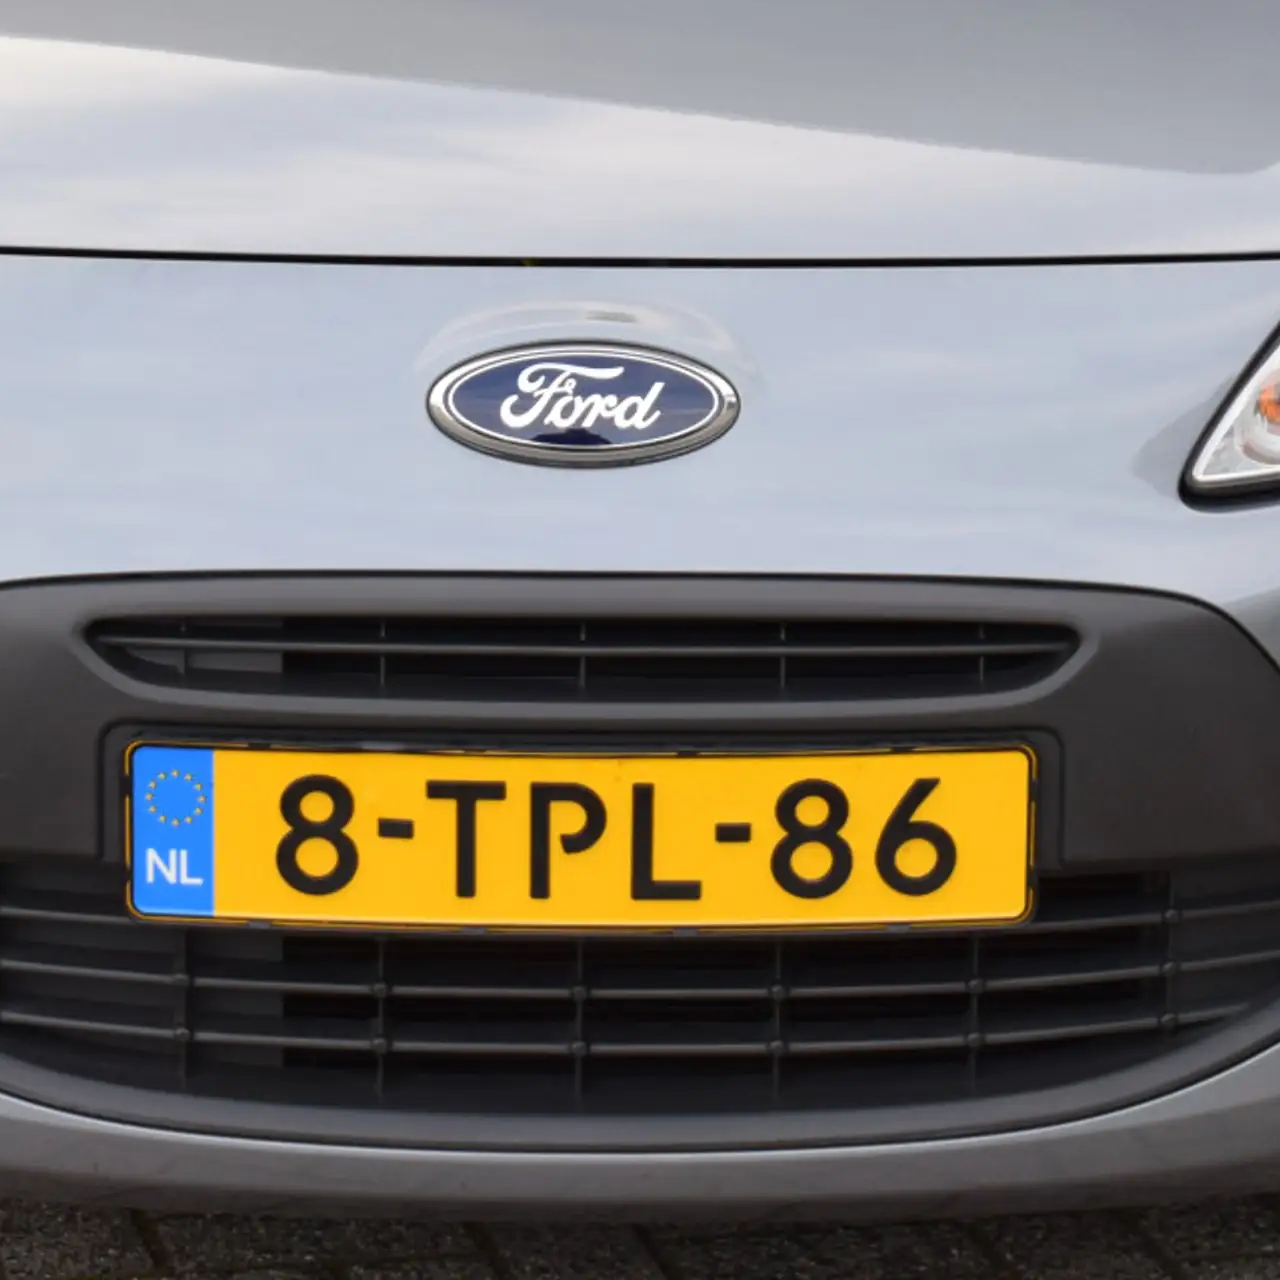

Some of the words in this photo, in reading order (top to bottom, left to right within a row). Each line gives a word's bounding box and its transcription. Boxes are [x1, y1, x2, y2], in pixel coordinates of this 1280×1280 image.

[499, 362, 665, 430] Ford
[146, 847, 204, 885] NL
[275, 773, 958, 900] 8-TPL-86
